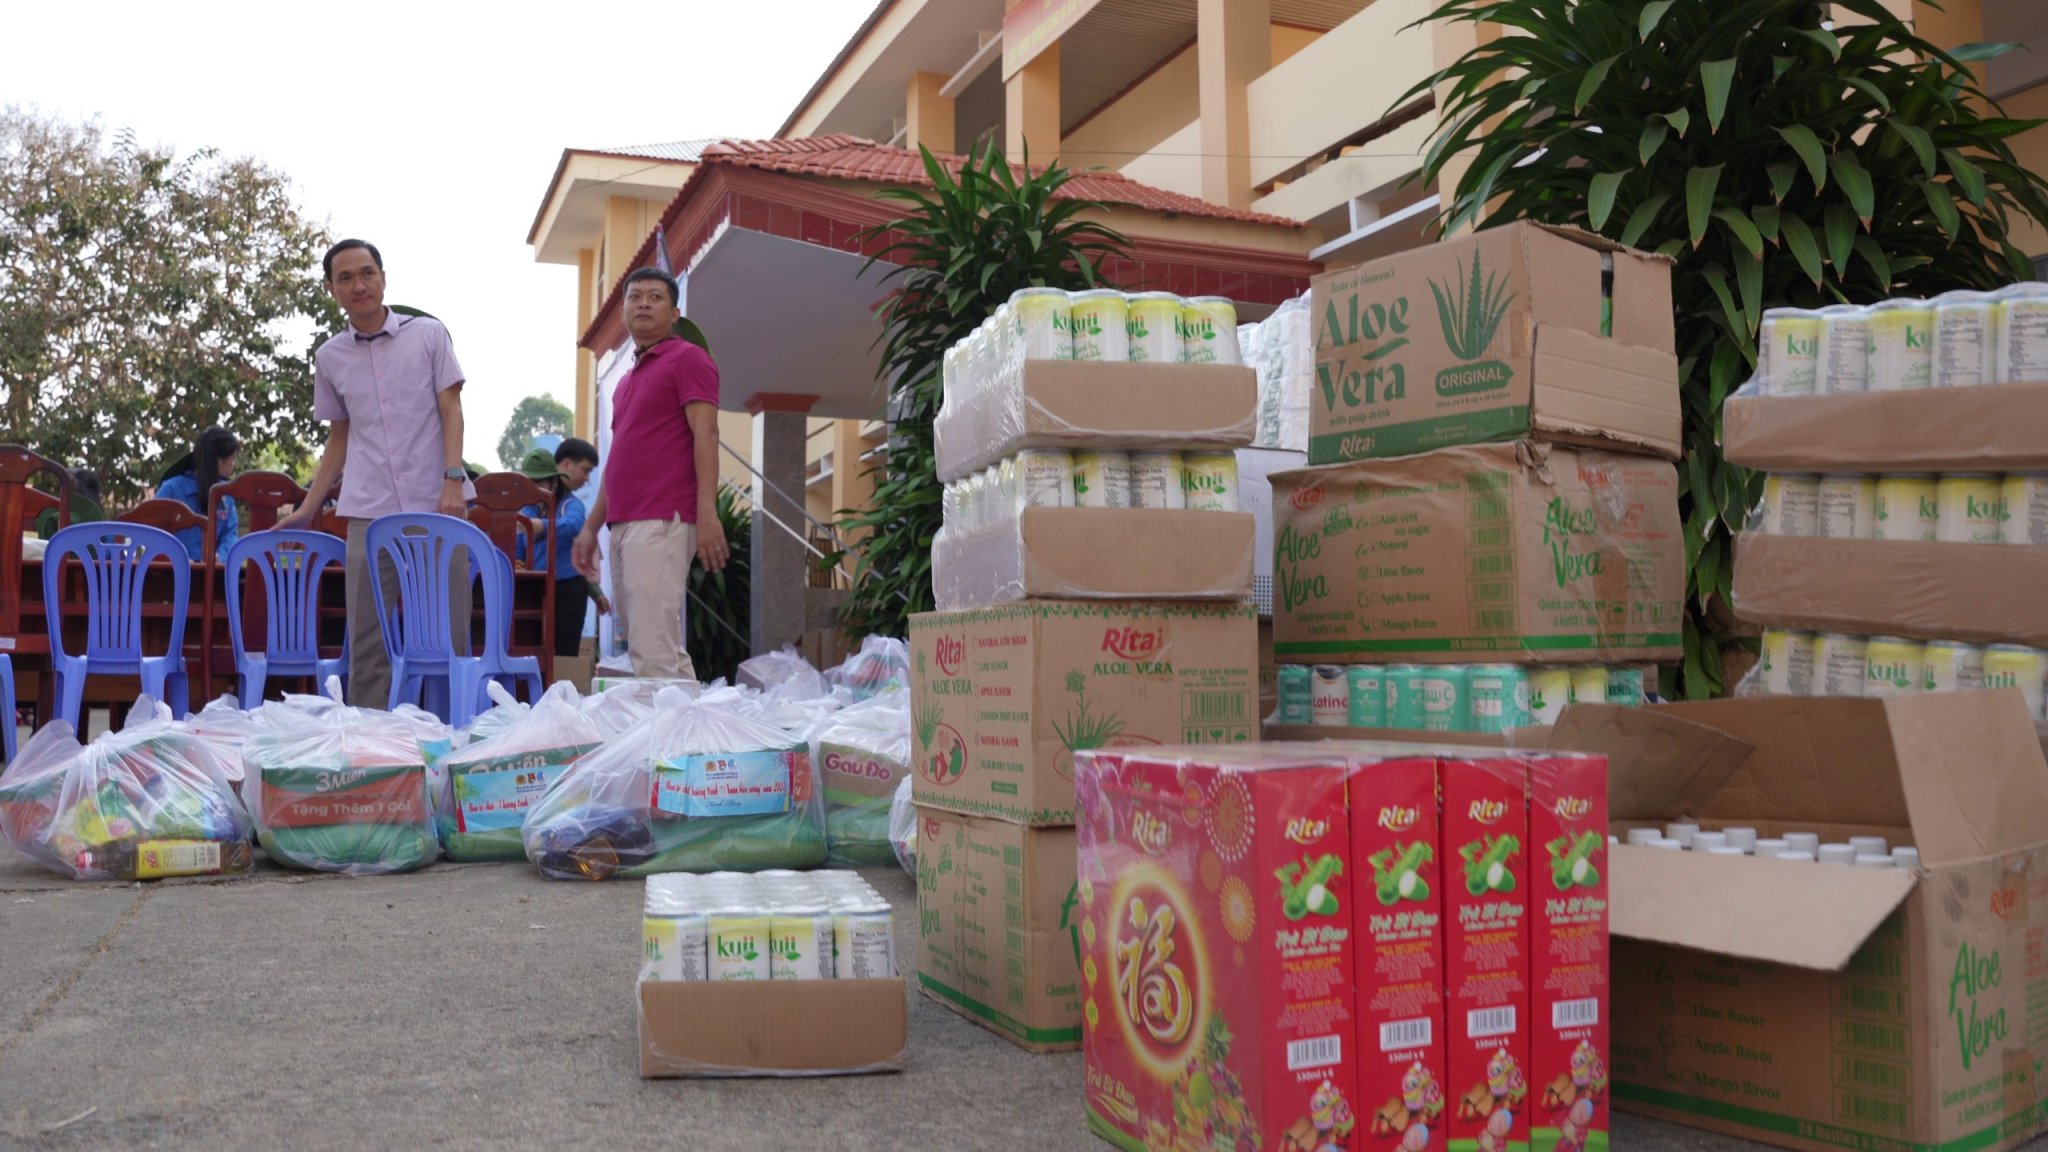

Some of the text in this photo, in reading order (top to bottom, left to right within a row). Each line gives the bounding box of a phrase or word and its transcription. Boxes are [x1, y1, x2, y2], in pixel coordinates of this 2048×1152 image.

[1316, 292, 1409, 352] Aloe
[1314, 358, 1407, 413] Vera
[1440, 365, 1505, 390] ORIGINAL
[1330, 408, 1391, 427] with pulp drink
[1275, 525, 1321, 573] Aloe
[1551, 538, 1605, 589] Vera
[1401, 565, 1425, 575] flavor
[1281, 563, 1329, 613] Vera
[1381, 618, 1437, 631] Mango flavor
[1093, 661, 1174, 675] ALOE VERA
[932, 679, 972, 695] ALOE VERA
[917, 852, 938, 893] Aloe
[919, 896, 941, 940] Vera
[1692, 968, 1739, 988] Natural
[1949, 940, 2001, 1018] Aloe
[1693, 1002, 1765, 1026] Lime flavor
[1957, 999, 2009, 1071] Vera
[1695, 1038, 1774, 1064] Apple flavor
[1695, 1072, 1781, 1101] Mango flavor
